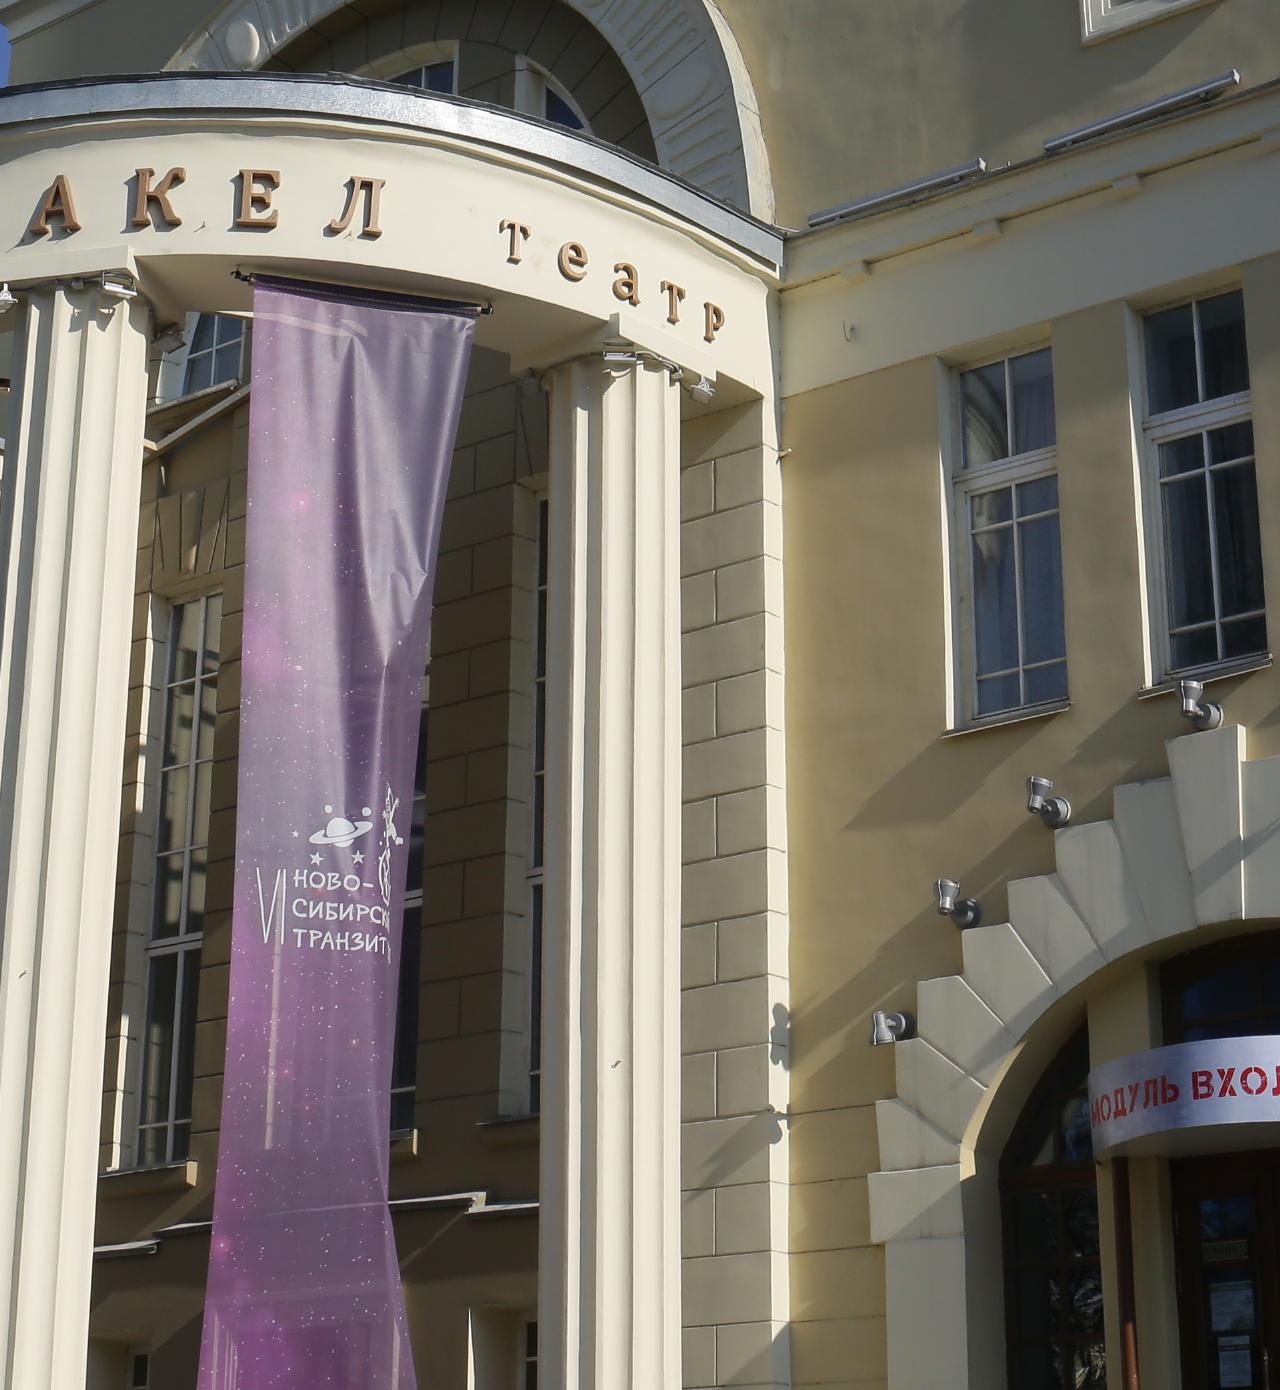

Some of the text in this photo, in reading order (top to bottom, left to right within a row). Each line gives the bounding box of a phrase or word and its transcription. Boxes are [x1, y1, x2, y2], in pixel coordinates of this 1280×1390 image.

[293, 868, 374, 892] НОВО-
[292, 898, 390, 934] СИБИРСК
[292, 928, 387, 956] ТРАНЗИТ
[1090, 1075, 1180, 1128] МОДУЛЬ
